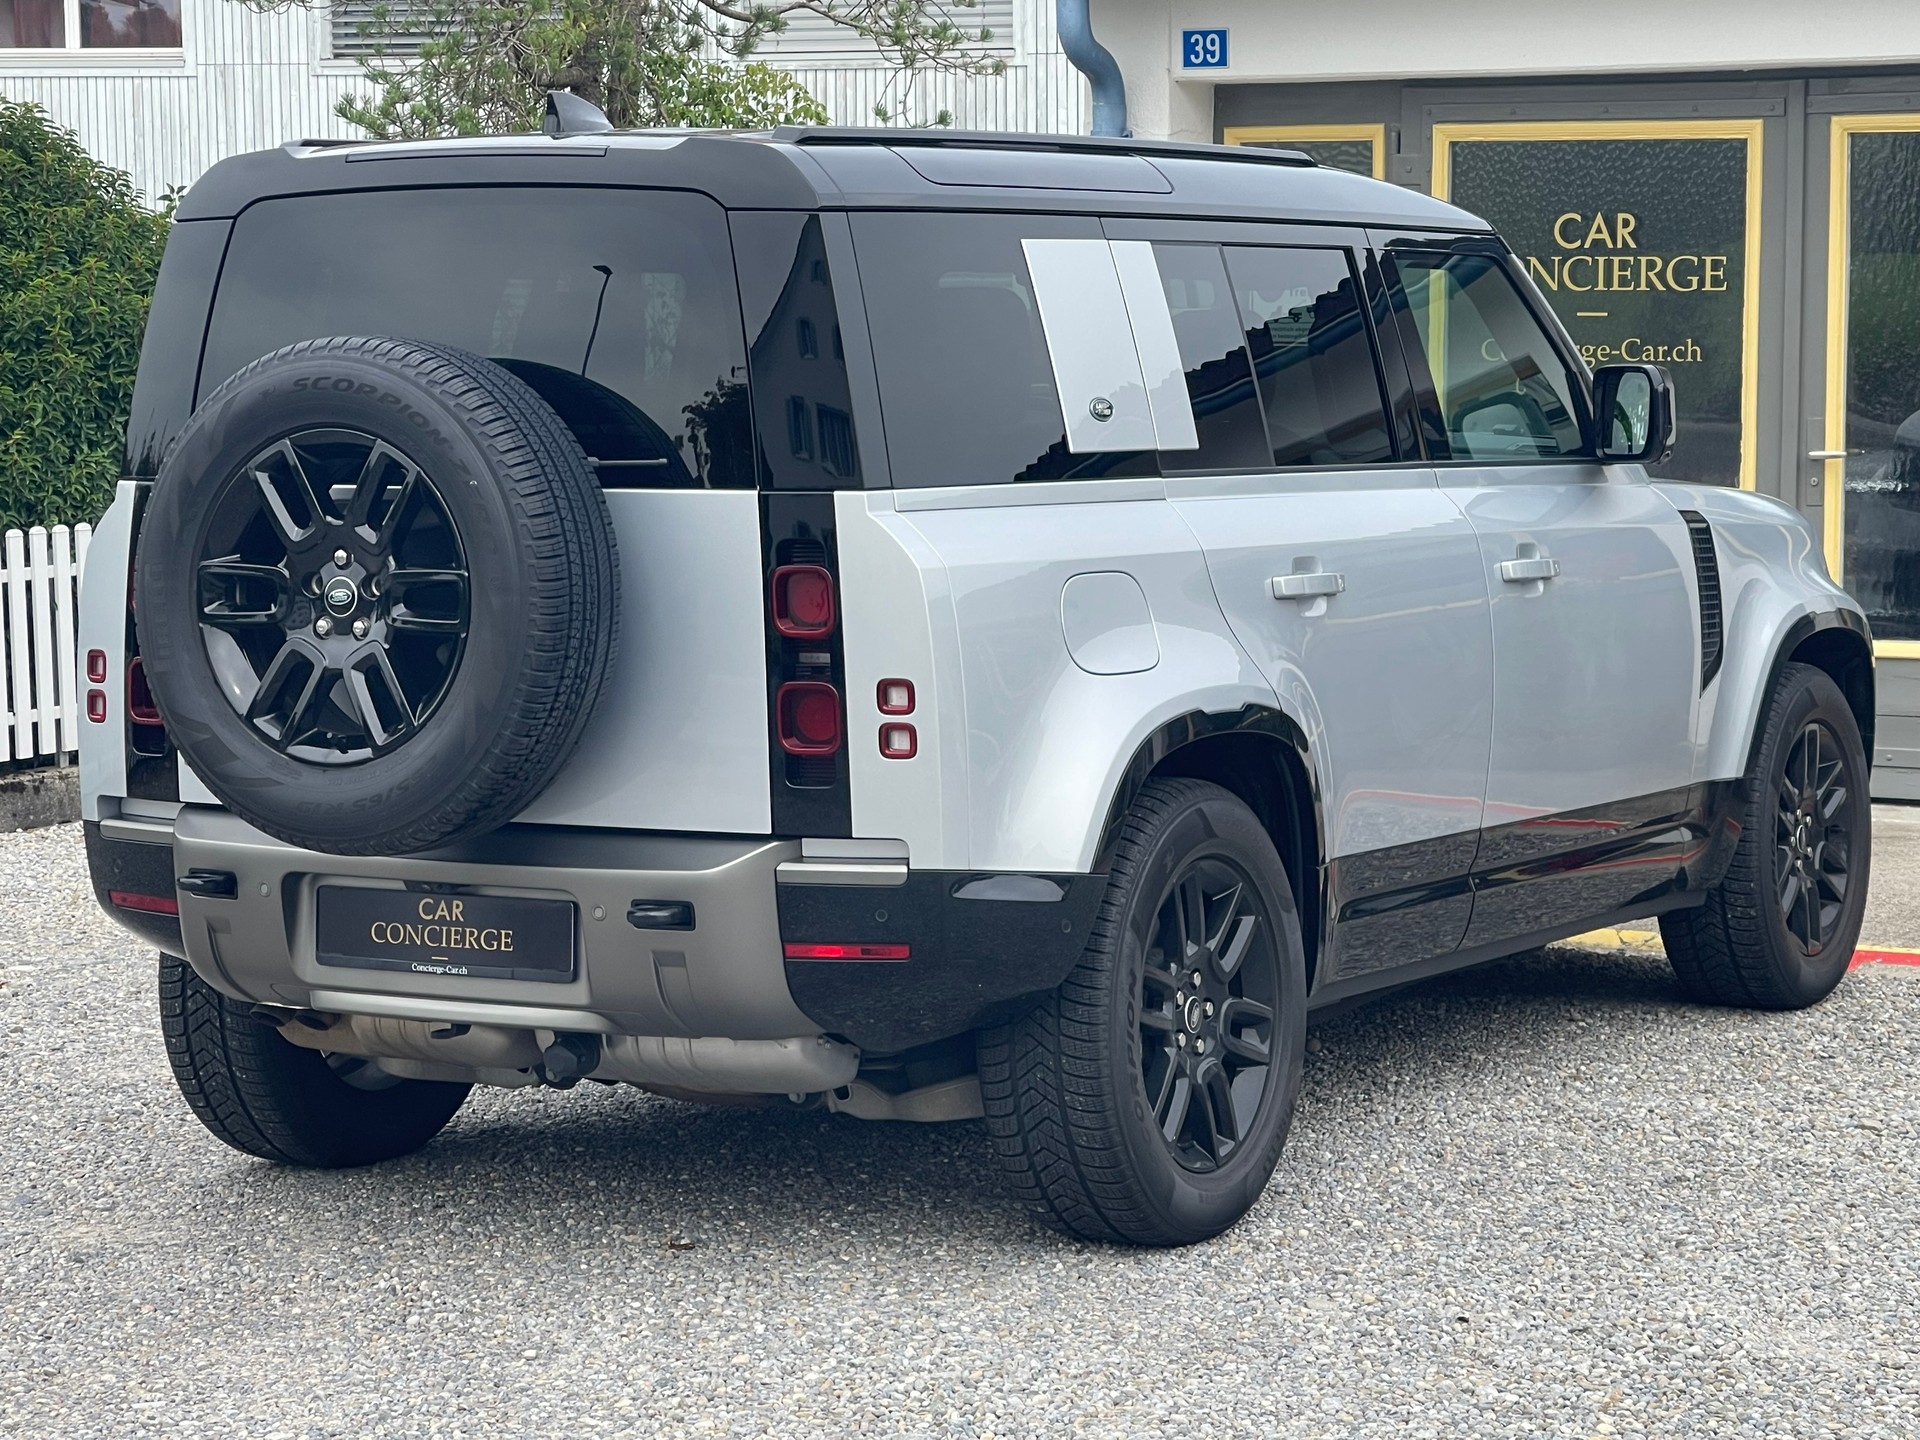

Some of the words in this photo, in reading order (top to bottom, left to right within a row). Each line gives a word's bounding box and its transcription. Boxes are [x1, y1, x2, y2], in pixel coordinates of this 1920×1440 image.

[1190, 33, 1220, 64] 39
[1553, 211, 1637, 249] CAR
[1516, 255, 1728, 292] NCIERGE
[293, 376, 450, 446] SCORPION
[418, 898, 464, 921] CAR
[371, 921, 514, 951] CONCIERGE
[411, 962, 468, 975] Concierge-Car.ch
